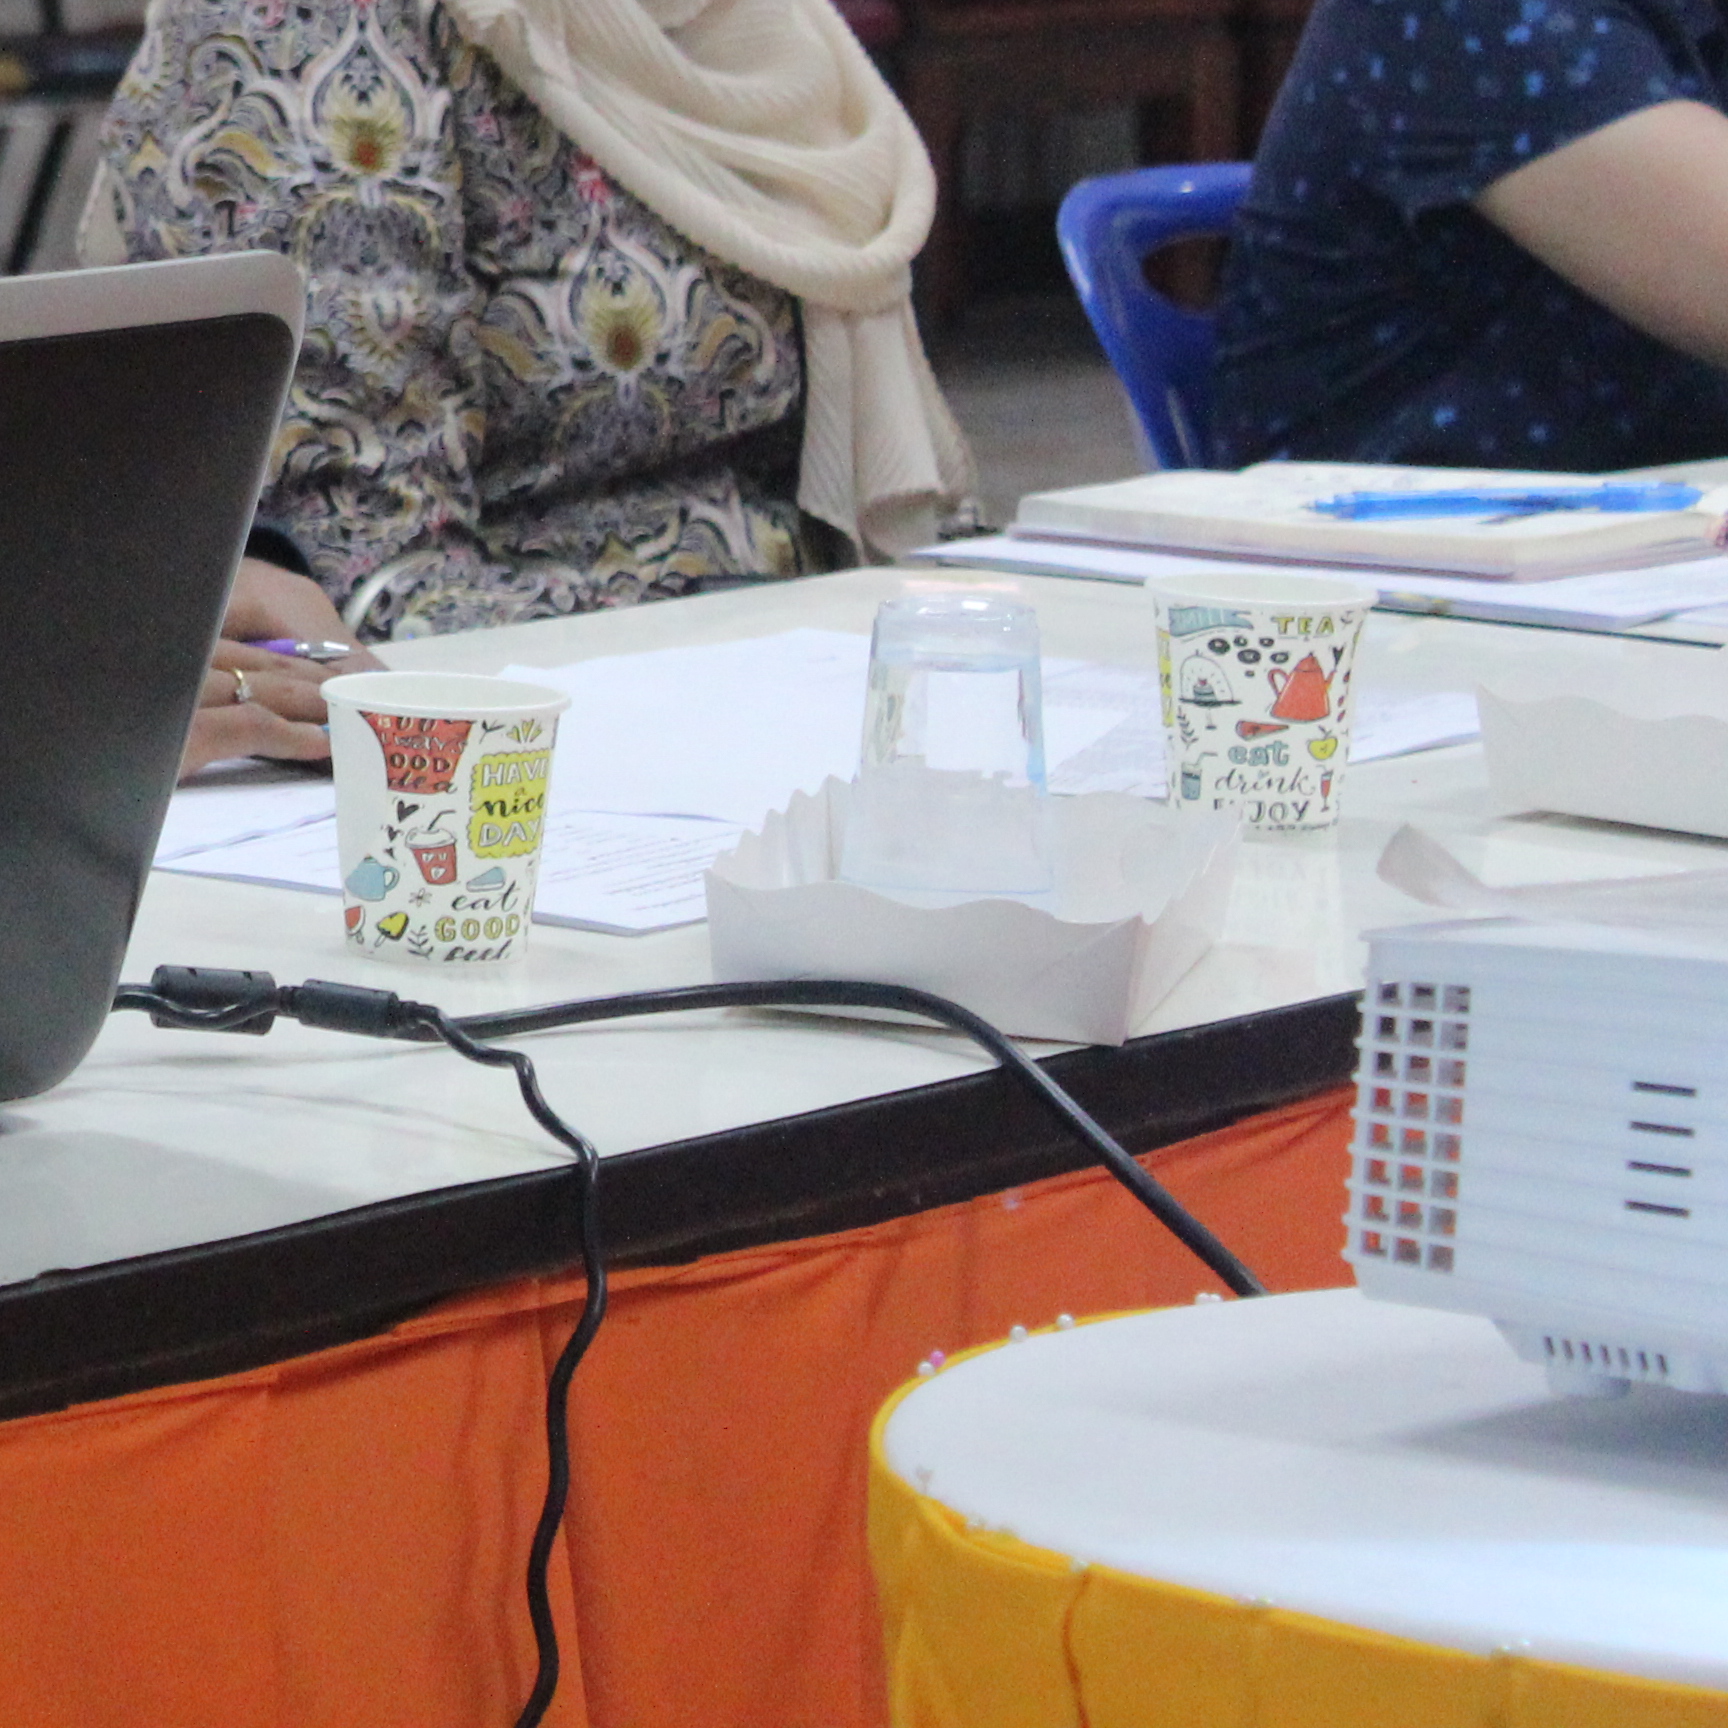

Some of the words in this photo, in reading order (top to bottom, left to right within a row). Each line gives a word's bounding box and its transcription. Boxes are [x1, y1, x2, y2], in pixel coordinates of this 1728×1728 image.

[1271, 616, 1334, 635] TEA
[1228, 740, 1289, 766] eat
[1215, 767, 1316, 795] drink
[478, 817, 542, 847] DAY
[451, 880, 521, 912] eat
[434, 913, 521, 942] GOOD
